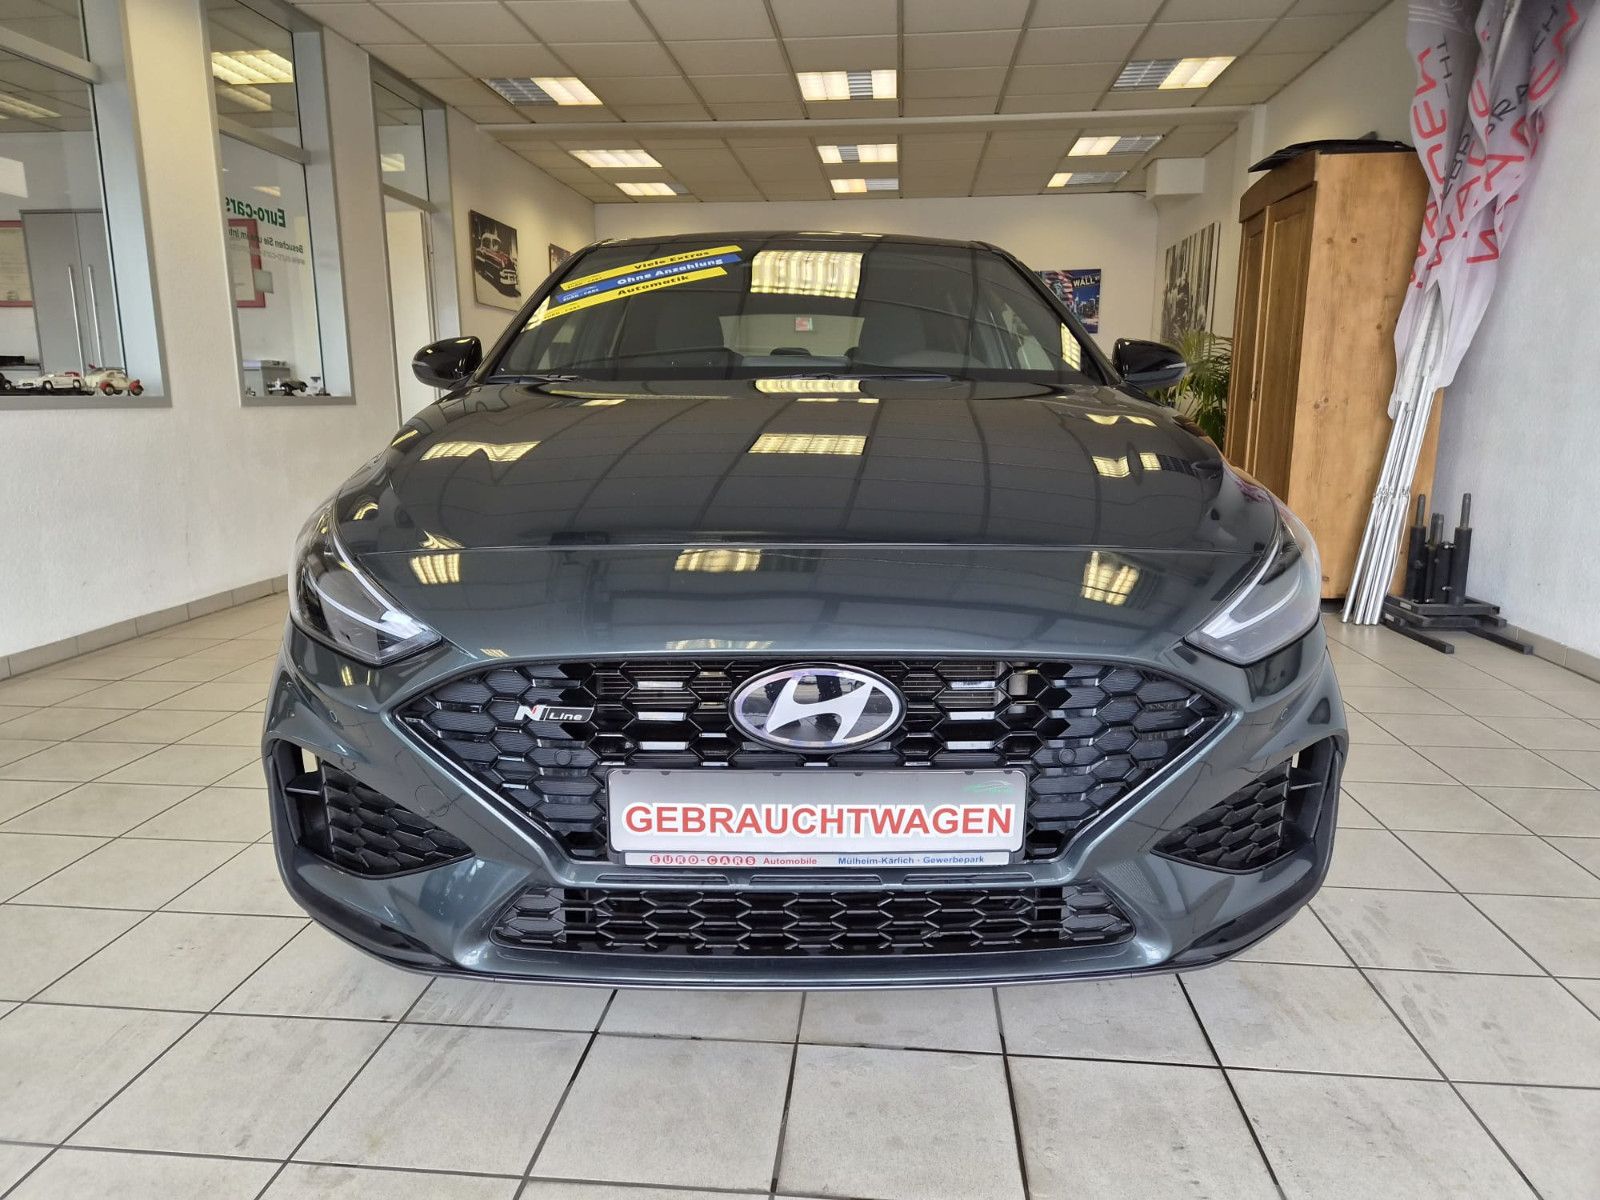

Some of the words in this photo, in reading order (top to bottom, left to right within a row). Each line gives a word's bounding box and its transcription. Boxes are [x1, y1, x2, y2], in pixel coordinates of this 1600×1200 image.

[634, 259, 666, 270] Viele
[670, 251, 709, 262] Extras
[617, 273, 652, 285] Ohne
[655, 258, 724, 277] Anzahlung
[618, 275, 689, 296] Automatik
[1073, 276, 1095, 288] WALL
[549, 712, 583, 720] Line
[625, 804, 1013, 836] GEBRAUCHTWAGEN
[763, 857, 817, 865] Automobile
[923, 855, 984, 865] Gewerbepark
